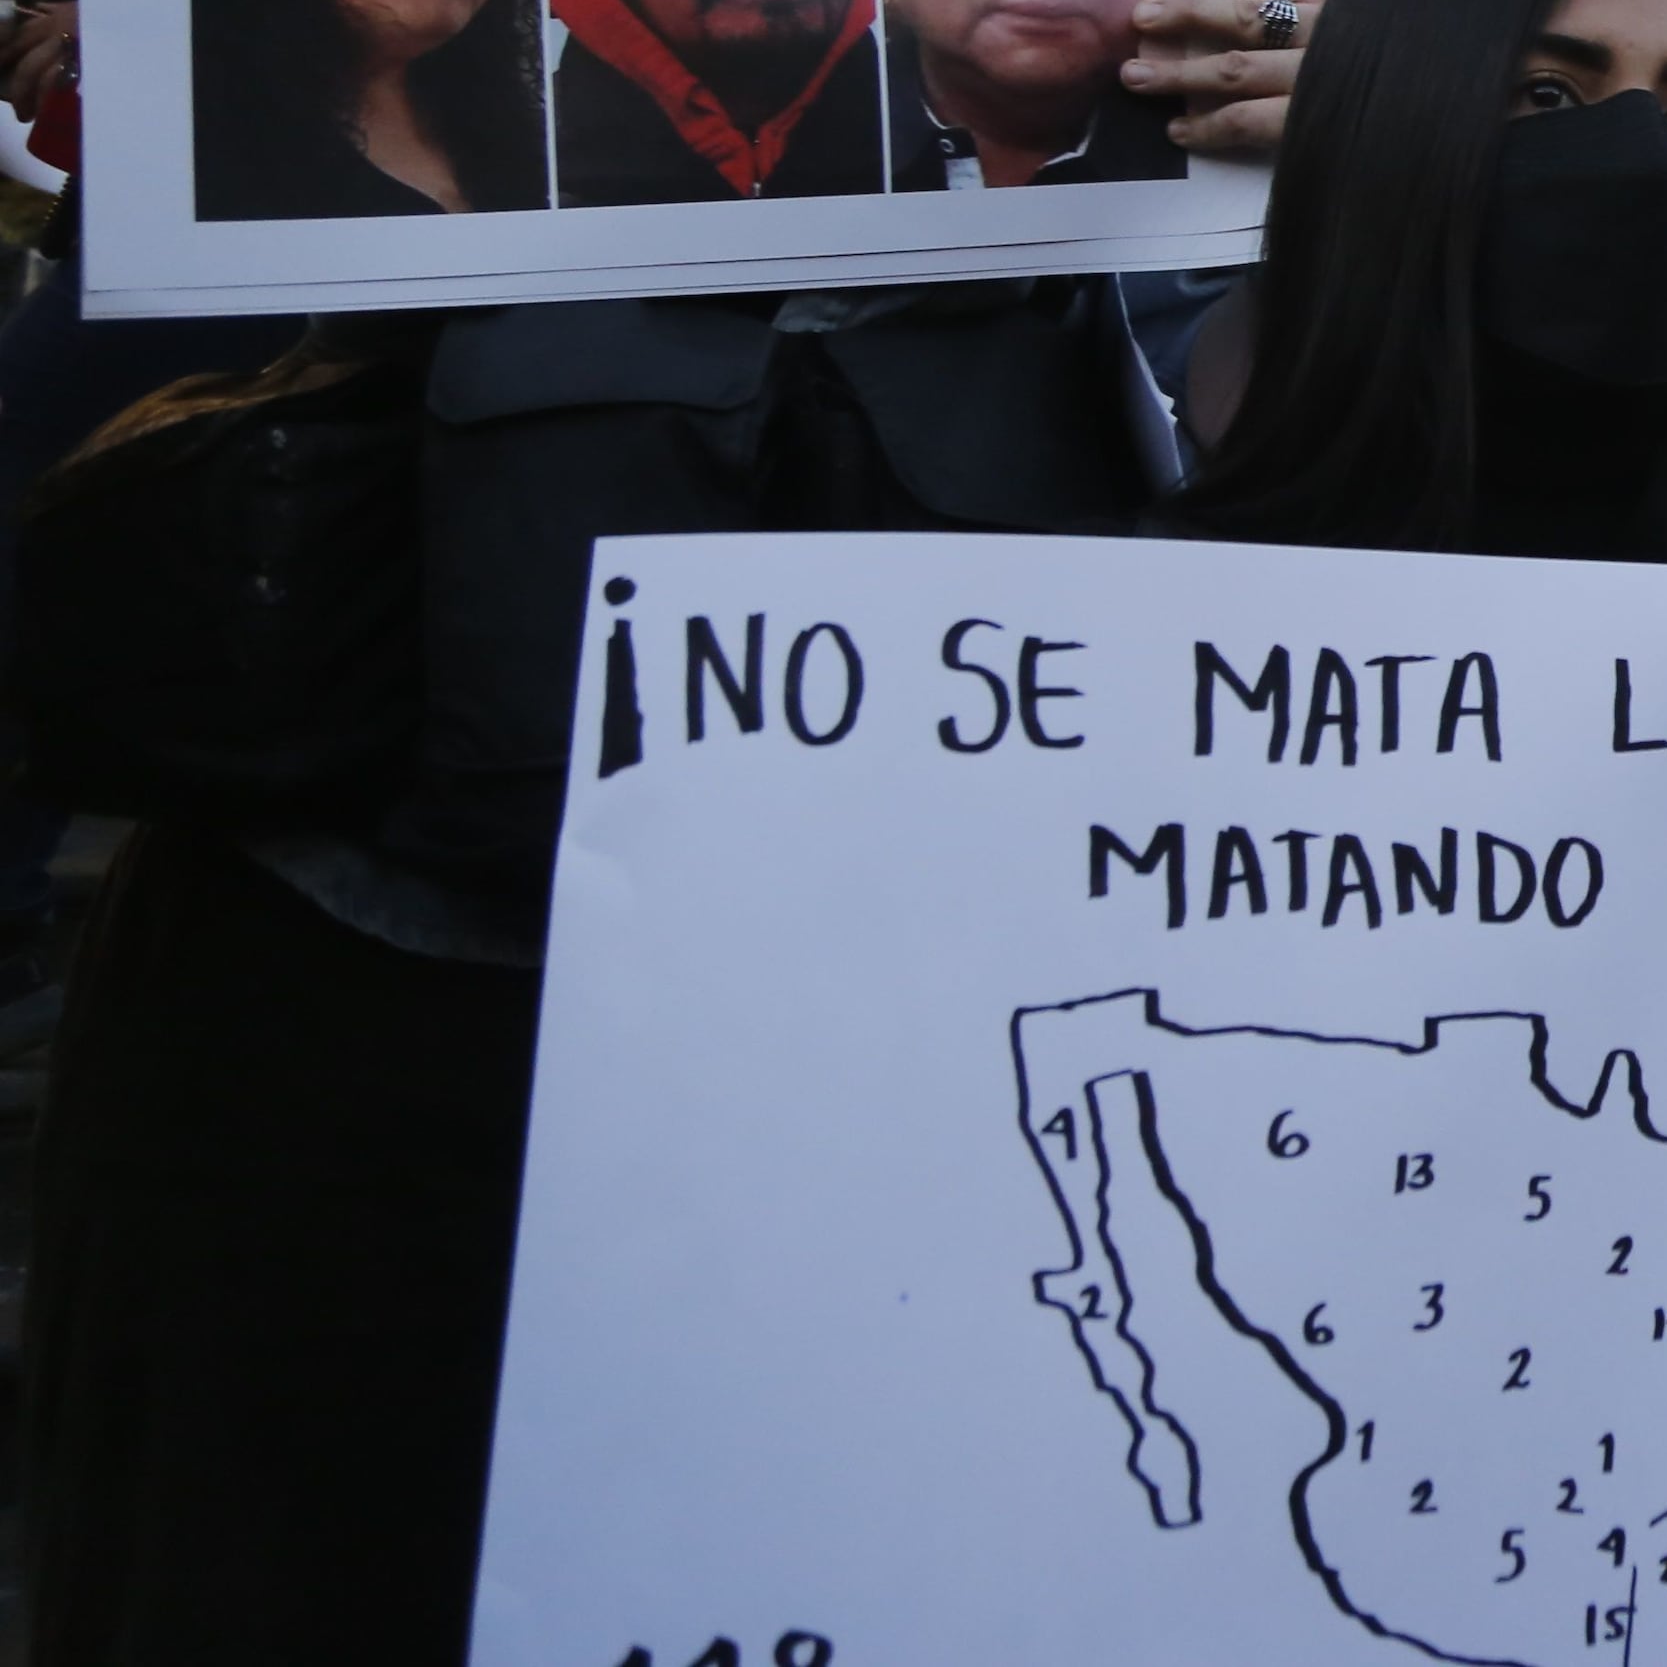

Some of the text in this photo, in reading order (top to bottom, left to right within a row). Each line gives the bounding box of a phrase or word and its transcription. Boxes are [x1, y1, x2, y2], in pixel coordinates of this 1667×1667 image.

[936, 617, 1089, 755] SE
[1194, 640, 1502, 766] MATA
[1088, 822, 1604, 930] MATANDO
[1266, 1109, 1311, 1159] 6
[1394, 1153, 1436, 1195] 13
[1524, 1174, 1552, 1222] 5
[1604, 1235, 1635, 1276] 2
[1077, 1285, 1109, 1320] 2
[1302, 1303, 1336, 1346] 6
[1412, 1282, 1446, 1332] 3
[1501, 1347, 1533, 1392] 2
[1356, 1419, 1377, 1463] 1
[1598, 1432, 1615, 1473] 1
[1409, 1478, 1439, 1515] 2
[1555, 1477, 1585, 1515] 2
[1495, 1529, 1528, 1584] 5
[1584, 1603, 1630, 1647] 15
